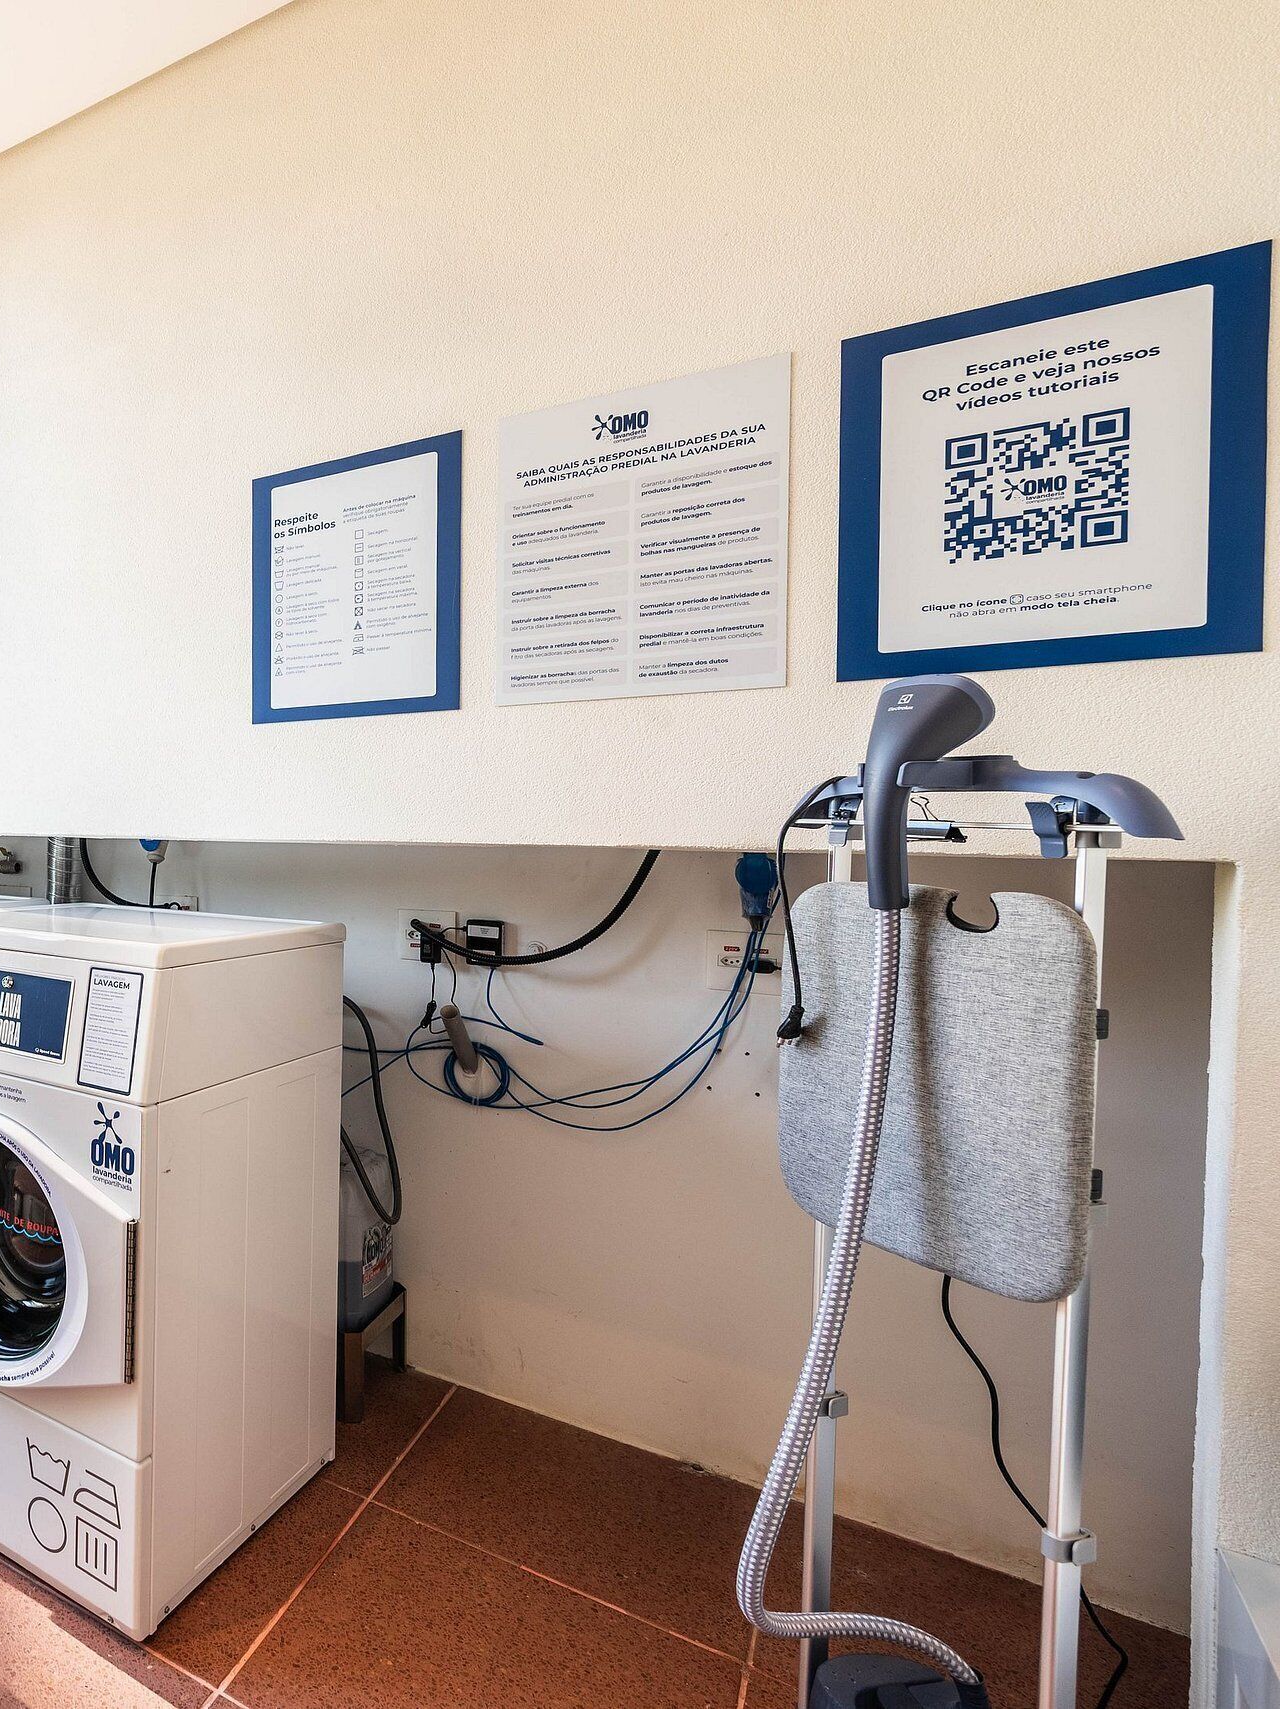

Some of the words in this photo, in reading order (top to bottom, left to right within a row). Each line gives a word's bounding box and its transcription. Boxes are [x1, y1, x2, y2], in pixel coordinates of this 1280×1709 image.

[966, 348, 1058, 377] Escaneie
[1063, 339, 1110, 356] este
[922, 386, 951, 403] QR
[956, 376, 1009, 395] Code
[1014, 373, 1027, 383] e
[1031, 362, 1076, 380] veja
[1083, 346, 1161, 370] nossos
[955, 391, 1023, 411] vídeos
[1027, 370, 1120, 398] tutoriais
[611, 410, 649, 435] OMO
[612, 428, 647, 440] lavanderia
[516, 467, 546, 480] SAIBA
[547, 460, 580, 474] QUAIS
[581, 457, 596, 467] AS
[598, 432, 718, 464] RESPONSABILIDADES
[720, 429, 739, 439] DA
[741, 423, 766, 435] SUA
[523, 465, 609, 488] ADMINISTRAÇÃO
[611, 455, 658, 471] PREDIAL
[660, 451, 677, 462] NA
[680, 436, 756, 458] LAVANDERIA
[641, 486, 671, 497] produtos
[681, 479, 713, 489] lavagem.
[1023, 474, 1068, 497] OMO
[1025, 490, 1066, 501] lavanderia
[512, 508, 551, 519] treinamentos
[672, 504, 705, 514] reposição
[705, 499, 731, 508] correta
[274, 512, 319, 528] Respeite
[640, 517, 671, 528] produtos
[681, 511, 712, 520] lavagem.
[273, 530, 286, 539] os
[287, 520, 336, 537] Símbolos
[511, 531, 536, 540] Orientar
[558, 520, 606, 533] funcionamento
[640, 541, 668, 549] Verificar
[668, 534, 711, 545] visualmente
[717, 528, 750, 539] presença
[640, 549, 662, 557] bolhas
[676, 541, 717, 552] mangueiras
[639, 572, 664, 580] Manter
[673, 568, 695, 577] portas
[709, 561, 743, 571] lavadoras
[743, 557, 773, 566] abertas.
[639, 601, 676, 610] Comunicar
[719, 591, 760, 601] inatividade
[1026, 593, 1052, 602] caso
[1054, 591, 1075, 599] seu
[1078, 583, 1153, 597] smartphone
[921, 603, 956, 613] Clique
[976, 598, 1008, 607] ícone
[949, 611, 969, 619] não
[971, 608, 996, 617] abra
[998, 604, 1017, 614] em
[1020, 602, 1055, 612] modo
[1057, 599, 1080, 608] tela
[639, 631, 684, 640] Disponibilizar
[715, 623, 765, 633] infraestrutura
[647, 669, 679, 677] exaustão
[93, 978, 131, 990] LAVAGEM
[91, 1138, 135, 1176] OMO
[92, 1165, 132, 1184] lavanderia
[92, 1175, 133, 1192] compartilhada
